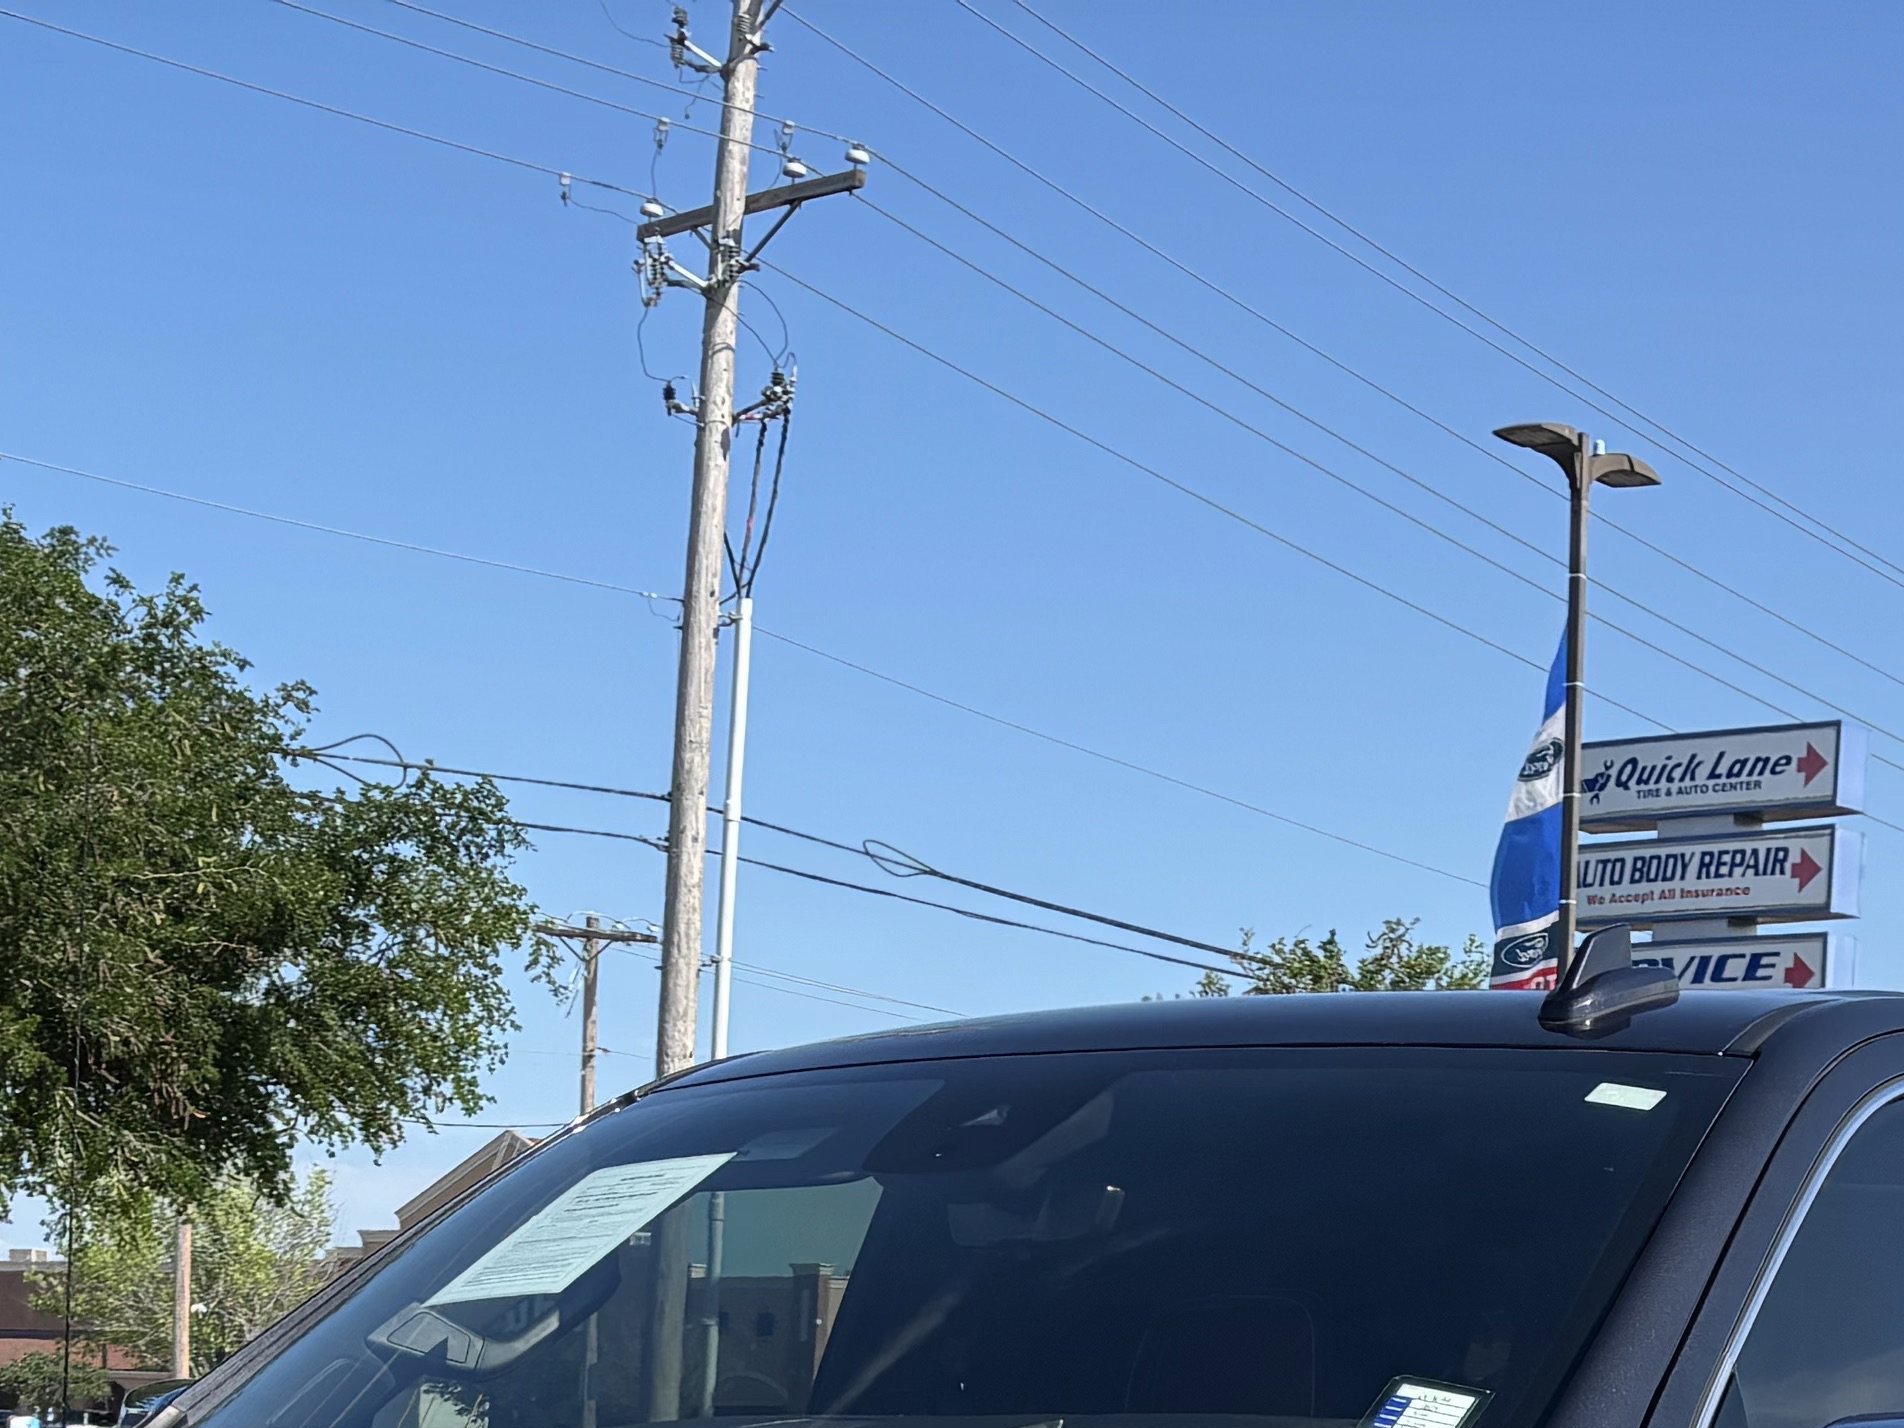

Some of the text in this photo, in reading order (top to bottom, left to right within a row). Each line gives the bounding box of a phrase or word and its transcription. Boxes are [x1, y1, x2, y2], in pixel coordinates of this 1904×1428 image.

[1614, 750, 1793, 791] Quick Lane
[1636, 779, 1763, 800] TIRE & AUTO CENTER
[1629, 850, 1697, 885] BODY
[1696, 846, 1790, 881] REPAIR
[1587, 885, 1751, 906] We Accept All Insurance
[1632, 951, 1782, 985] VICE
